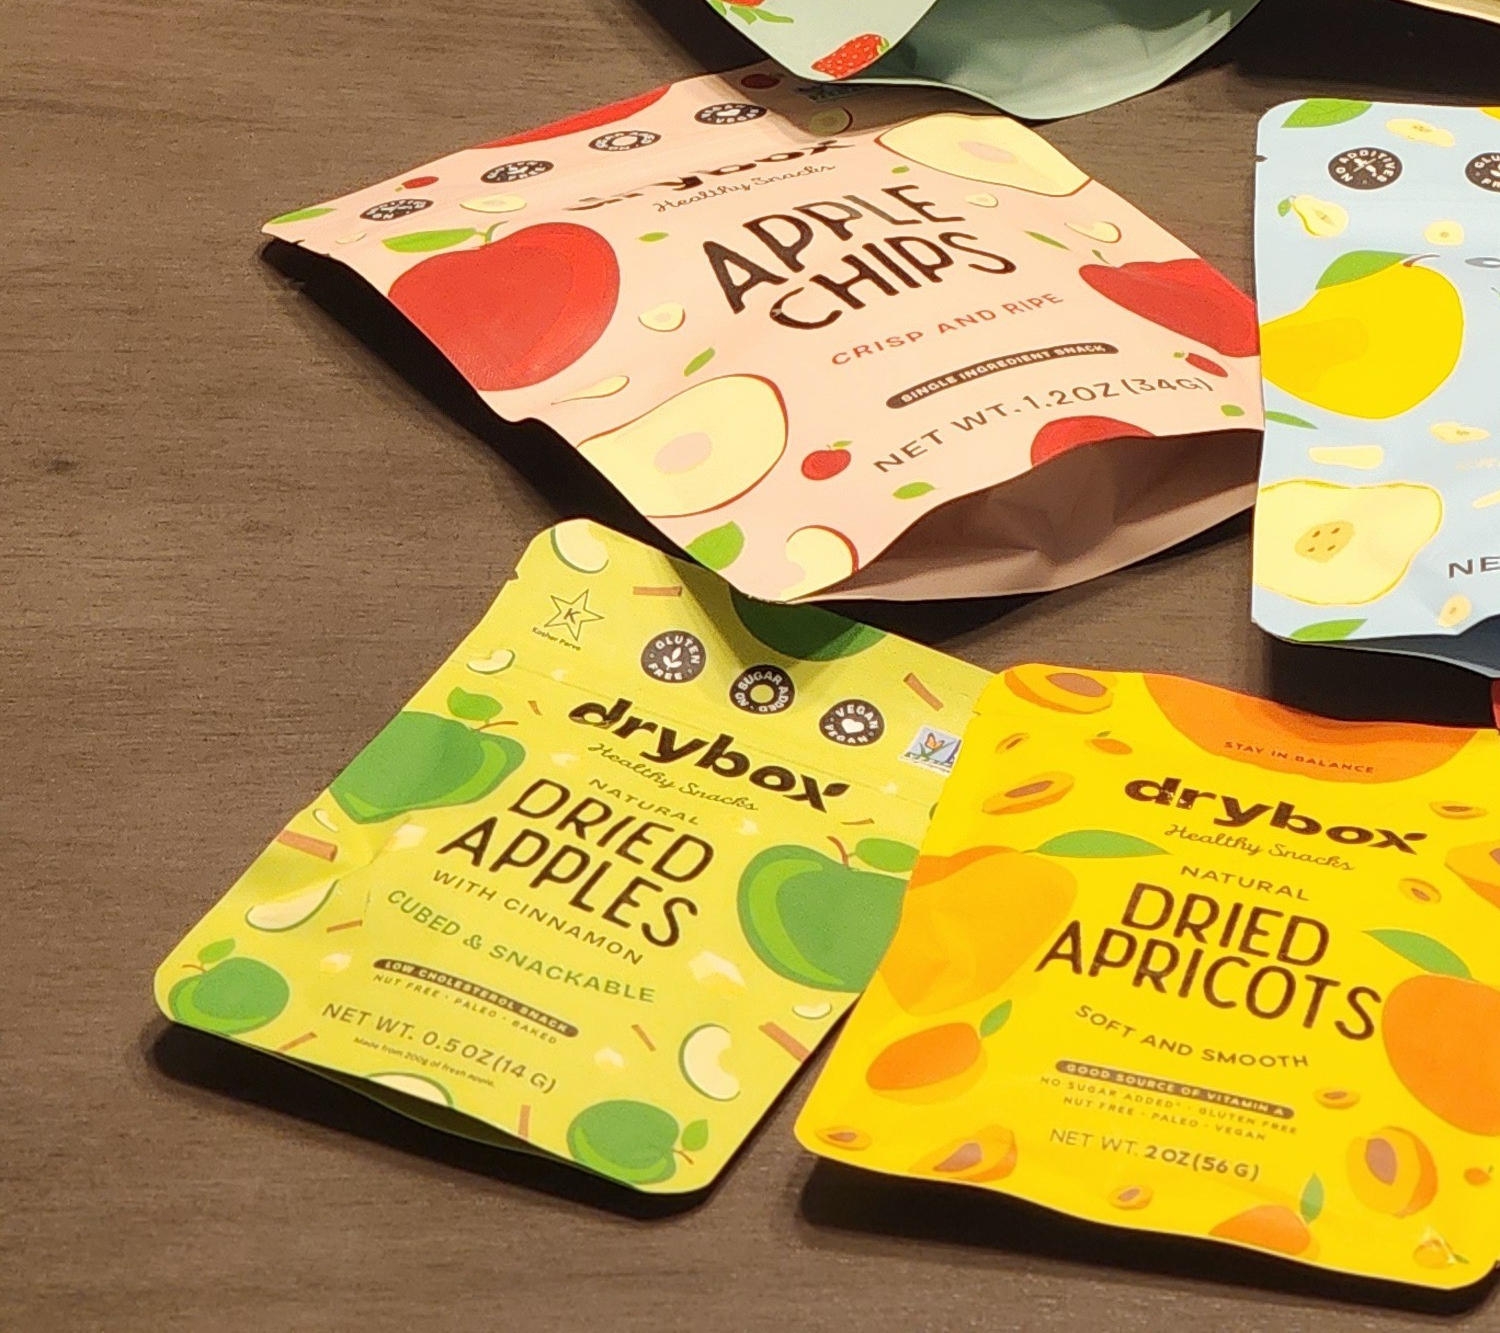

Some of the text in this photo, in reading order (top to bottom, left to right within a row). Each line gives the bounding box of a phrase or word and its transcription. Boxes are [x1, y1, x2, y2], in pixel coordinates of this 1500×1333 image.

[652, 164, 836, 213] Healthy Snacks
[1335, 167, 1352, 183] NO
[702, 184, 966, 315] APPLE
[770, 232, 1017, 331] CHIPS
[831, 292, 1065, 367] CRISP AND RIPE
[900, 349, 1052, 405] SINGLE INGREDIENT
[873, 429, 944, 473] NET
[568, 697, 851, 813] drybox
[587, 742, 759, 812] Healthy Snacks
[1223, 741, 1375, 774] STAY BALANCE
[507, 778, 715, 884] DRIED
[588, 778, 700, 826] NATURAL
[1124, 777, 1428, 855] drybox
[1164, 823, 1355, 871] Healthy Snacks
[435, 816, 698, 948] APPLES
[1180, 865, 1310, 902] NATURAL
[387, 889, 656, 1003] CUBED & SNACKABLE
[433, 869, 644, 966] WITH CINNAMON
[1120, 882, 1330, 968] DRIED
[418, 968, 568, 1034] CHOLESTEROL SNACK
[1033, 920, 1382, 1042] APRICOTS
[321, 1003, 414, 1041] NET WT.
[1075, 1004, 1309, 1068] SOFT AND SMOOTH
[1066, 1064, 1269, 1113] GOOD SOURCE VITAMIN
[1050, 1128, 1139, 1157] NET WT.
